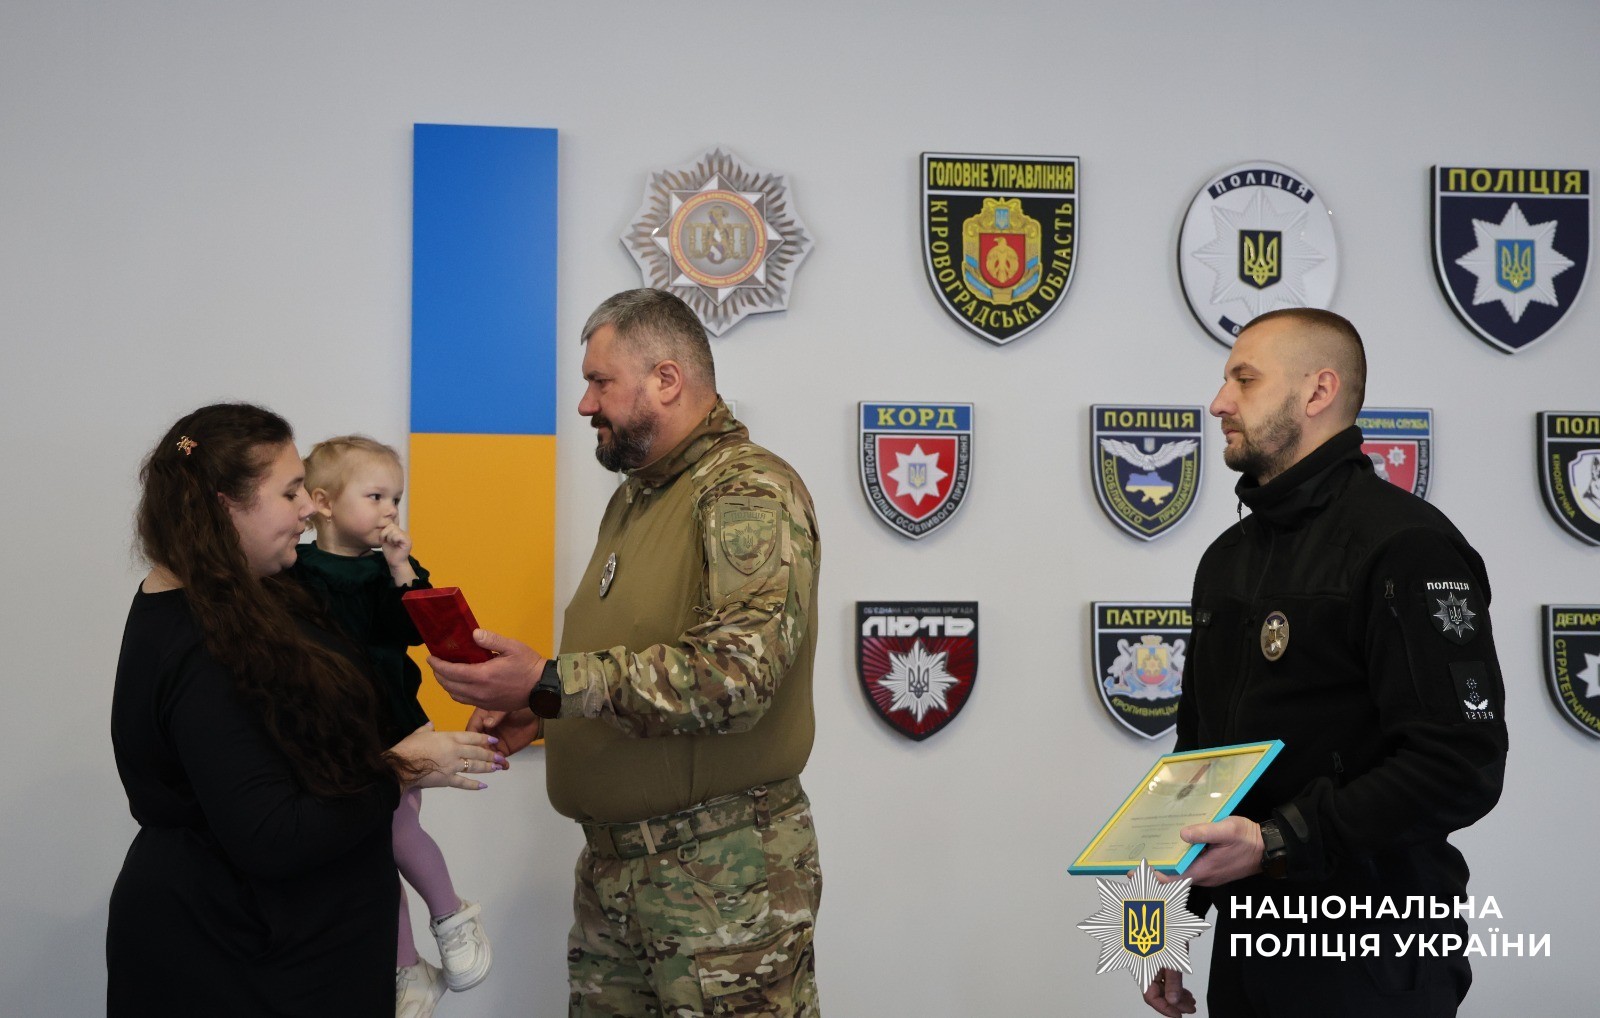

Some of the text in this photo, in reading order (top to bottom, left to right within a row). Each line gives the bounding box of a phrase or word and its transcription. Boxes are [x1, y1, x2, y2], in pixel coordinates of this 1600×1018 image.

[929, 161, 1074, 190] ГОЛОВНЕ УПРАВЛІННЯ
[1214, 172, 1308, 198] ПОЛІЦІЯ
[1449, 168, 1582, 195] ПОЛІЦІЯ
[930, 199, 1073, 328] КІРОВОГРАДСЬКА ОБЛАСТЬ
[877, 408, 958, 429] КОРД
[1104, 411, 1194, 429] ПОЛІЦІЯ
[896, 502, 955, 533] ОСОБЛИВОГО
[952, 435, 968, 501] ПРИЗНАЧЕННЯ
[1104, 459, 1143, 524] ОСОБЛИВОГО
[1426, 581, 1470, 591] ПОЛІЦІЯ
[862, 615, 975, 637] ЛЮТЬ
